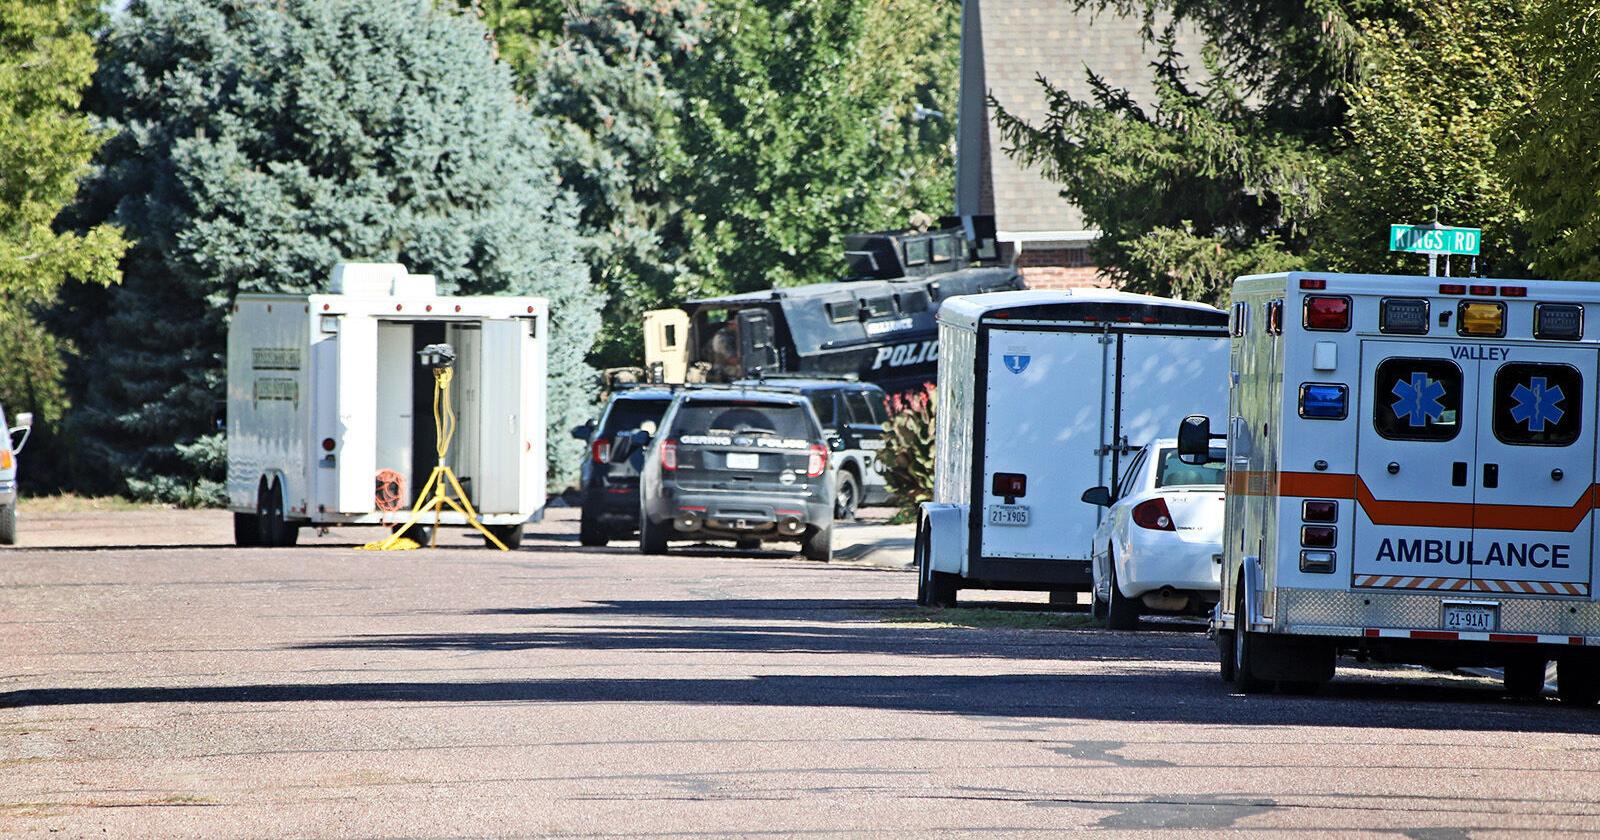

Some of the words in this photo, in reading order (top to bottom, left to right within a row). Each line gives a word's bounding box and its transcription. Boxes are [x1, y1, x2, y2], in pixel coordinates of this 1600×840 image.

[1395, 228, 1443, 249] KINGS
[1454, 231, 1476, 251] RD
[1450, 345, 1510, 361] VALLEY
[1375, 537, 1570, 569] AMBULANCE
[1448, 612, 1491, 628] 21-91AT
